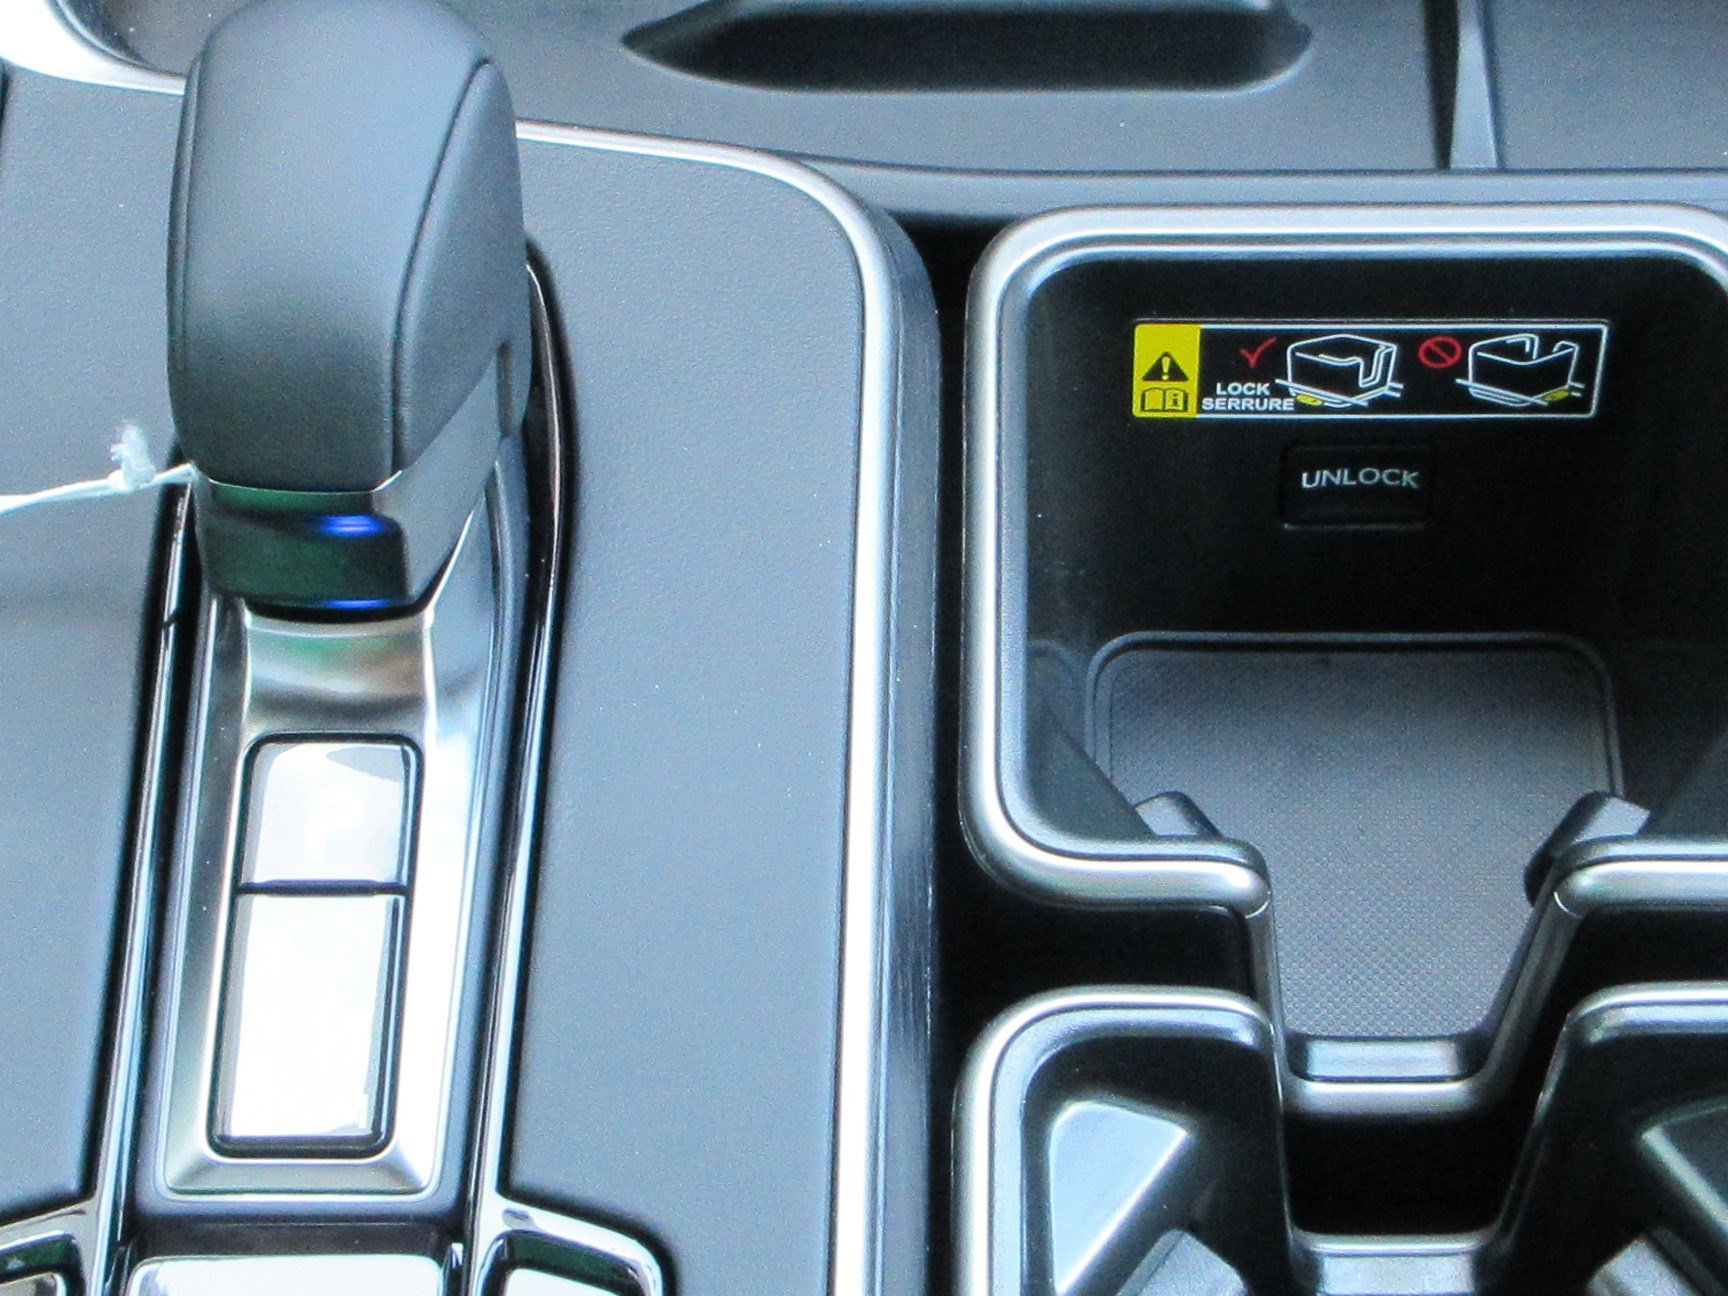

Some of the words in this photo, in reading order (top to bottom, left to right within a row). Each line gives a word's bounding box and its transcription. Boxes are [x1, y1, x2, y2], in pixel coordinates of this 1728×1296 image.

[1216, 382, 1271, 396] LOCK
[1201, 397, 1295, 411] SERRURE
[1301, 467, 1420, 489] UNLOCK
